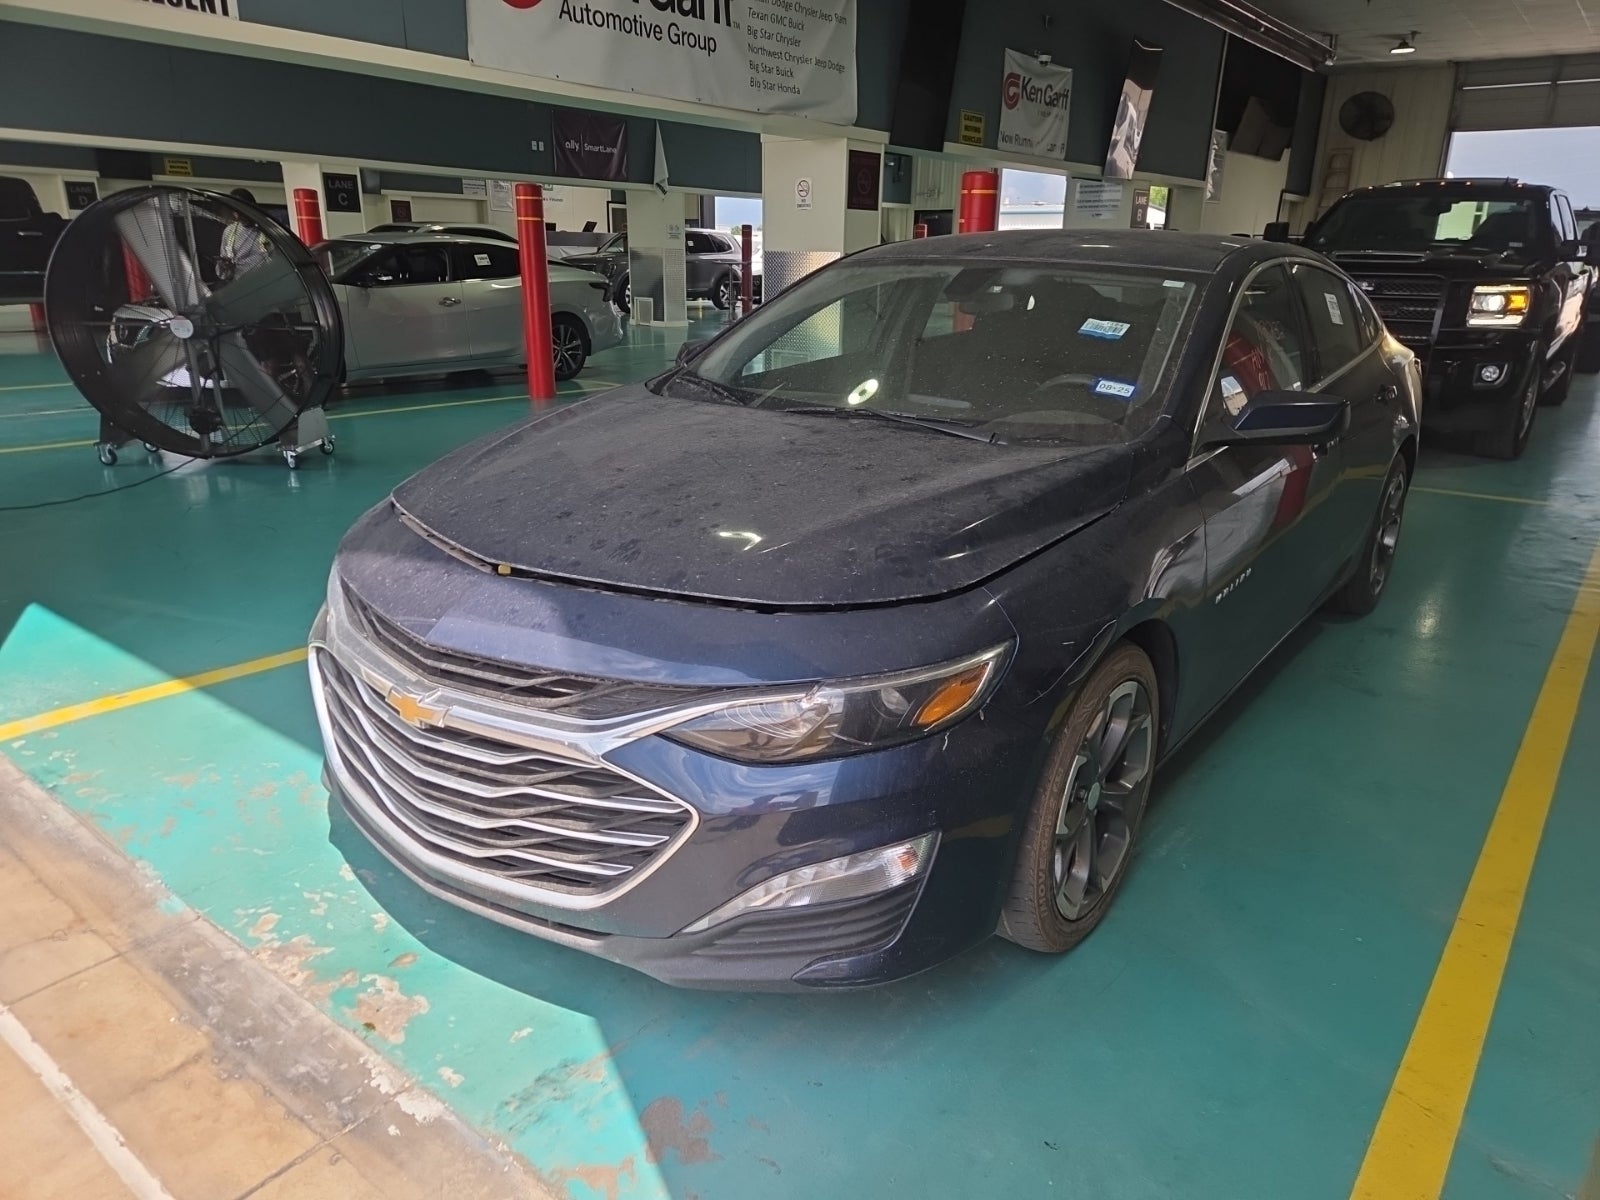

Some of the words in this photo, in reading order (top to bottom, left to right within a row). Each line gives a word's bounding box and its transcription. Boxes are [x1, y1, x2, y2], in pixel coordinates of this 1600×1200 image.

[748, 7, 769, 21] Texan
[770, 13, 787, 27] GMC
[788, 18, 805, 31] Buick
[818, 9, 833, 23] Jeep
[559, 0, 663, 42] Automotive
[667, 22, 717, 57] Group
[747, 25, 758, 40] Big
[760, 28, 774, 41] Star
[775, 32, 801, 48] Chrysler
[748, 43, 783, 60] Northwest
[784, 51, 812, 65] Chrysler
[814, 56, 827, 70] Jeep
[828, 60, 845, 75] Dodge
[749, 60, 760, 74] Big
[761, 62, 774, 74] Star
[776, 66, 794, 78] Buick
[749, 77, 761, 92] Big
[762, 80, 776, 91] Star
[777, 83, 801, 95] Honda
[565, 140, 580, 152] ally
[328, 178, 354, 190] LANE
[338, 192, 349, 206] C
[1135, 195, 1148, 206] LANE
